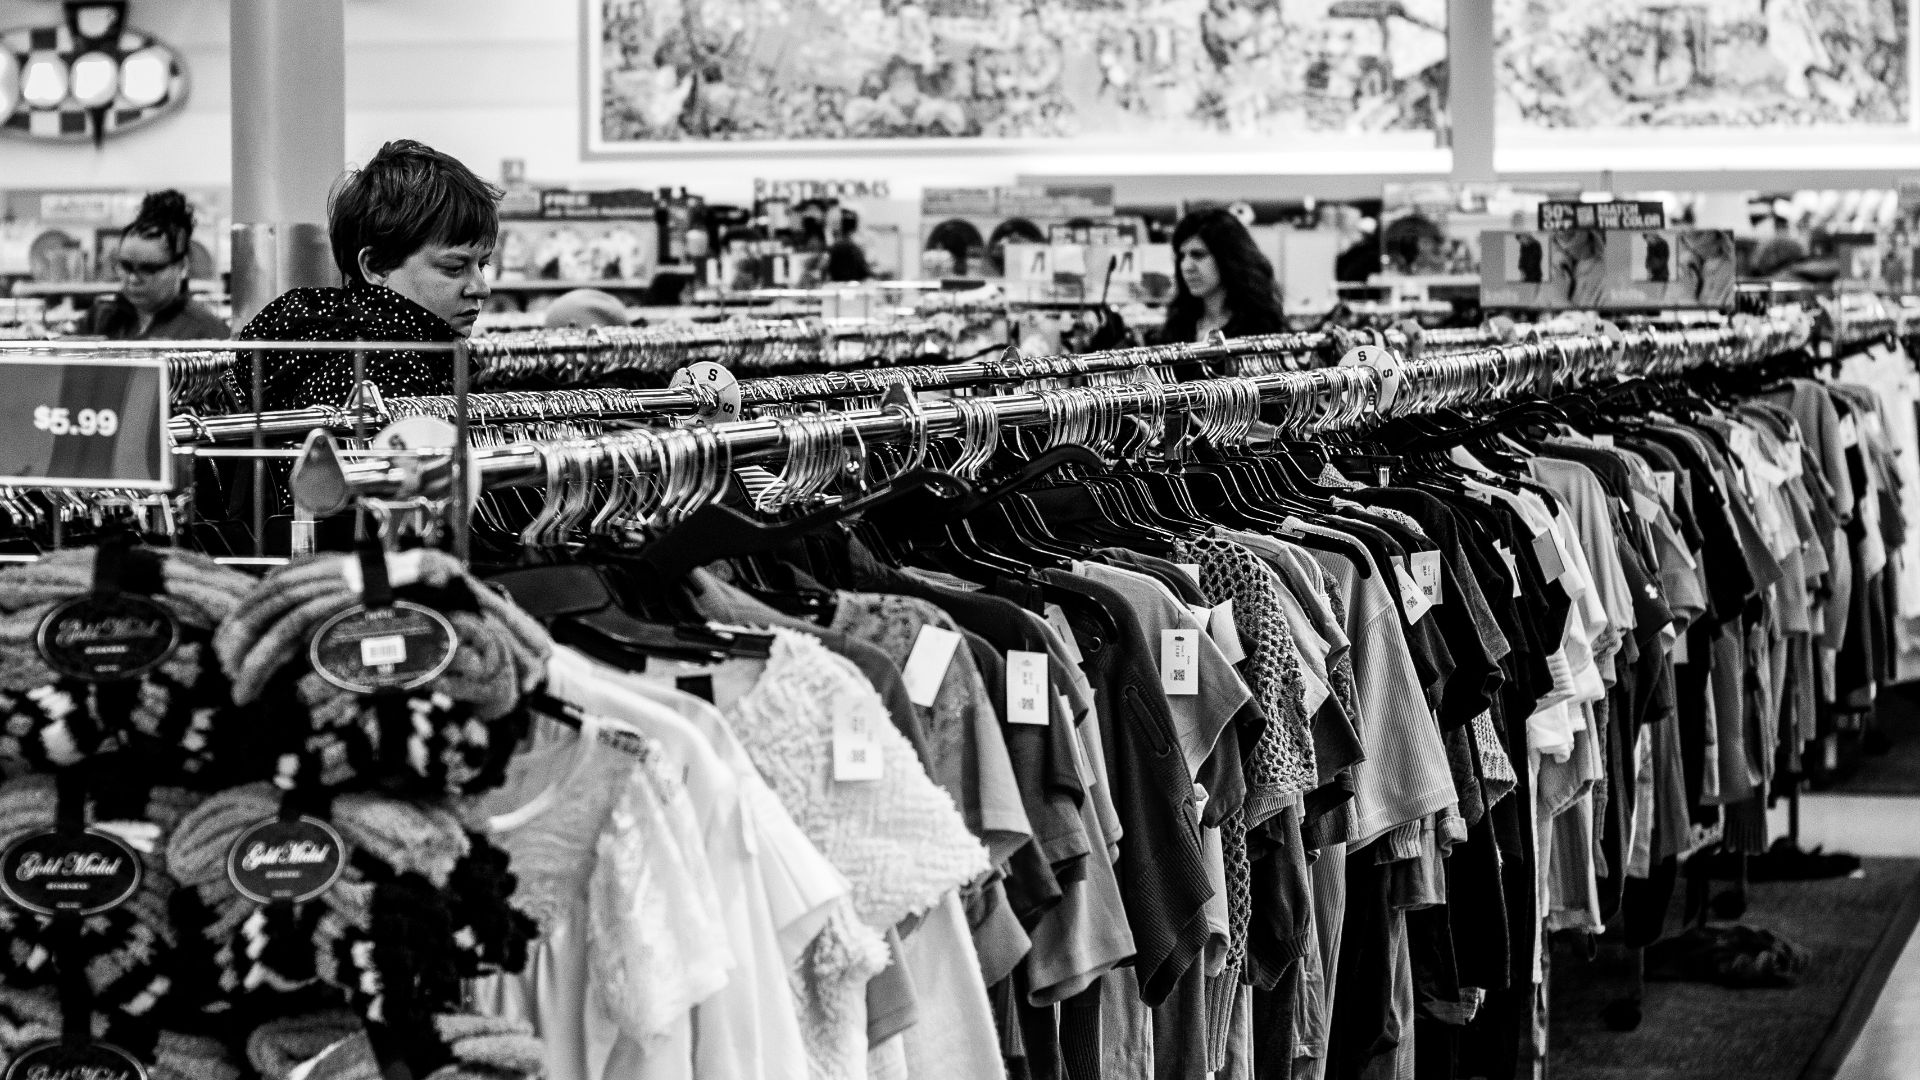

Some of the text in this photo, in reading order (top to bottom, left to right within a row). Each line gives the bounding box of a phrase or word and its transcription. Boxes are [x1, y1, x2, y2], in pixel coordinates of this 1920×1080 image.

[754, 177, 890, 200] RESTROOMS
[1597, 204, 1639, 216] MATCH
[1598, 215, 1619, 228] THE
[1622, 214, 1661, 227] COLOR
[1357, 350, 1367, 362] S
[707, 368, 718, 381] S
[1383, 368, 1393, 378] S
[722, 402, 735, 414] S
[33, 404, 119, 437] $5.99
[242, 840, 282, 871] Gold
[16, 851, 64, 881] Gold
